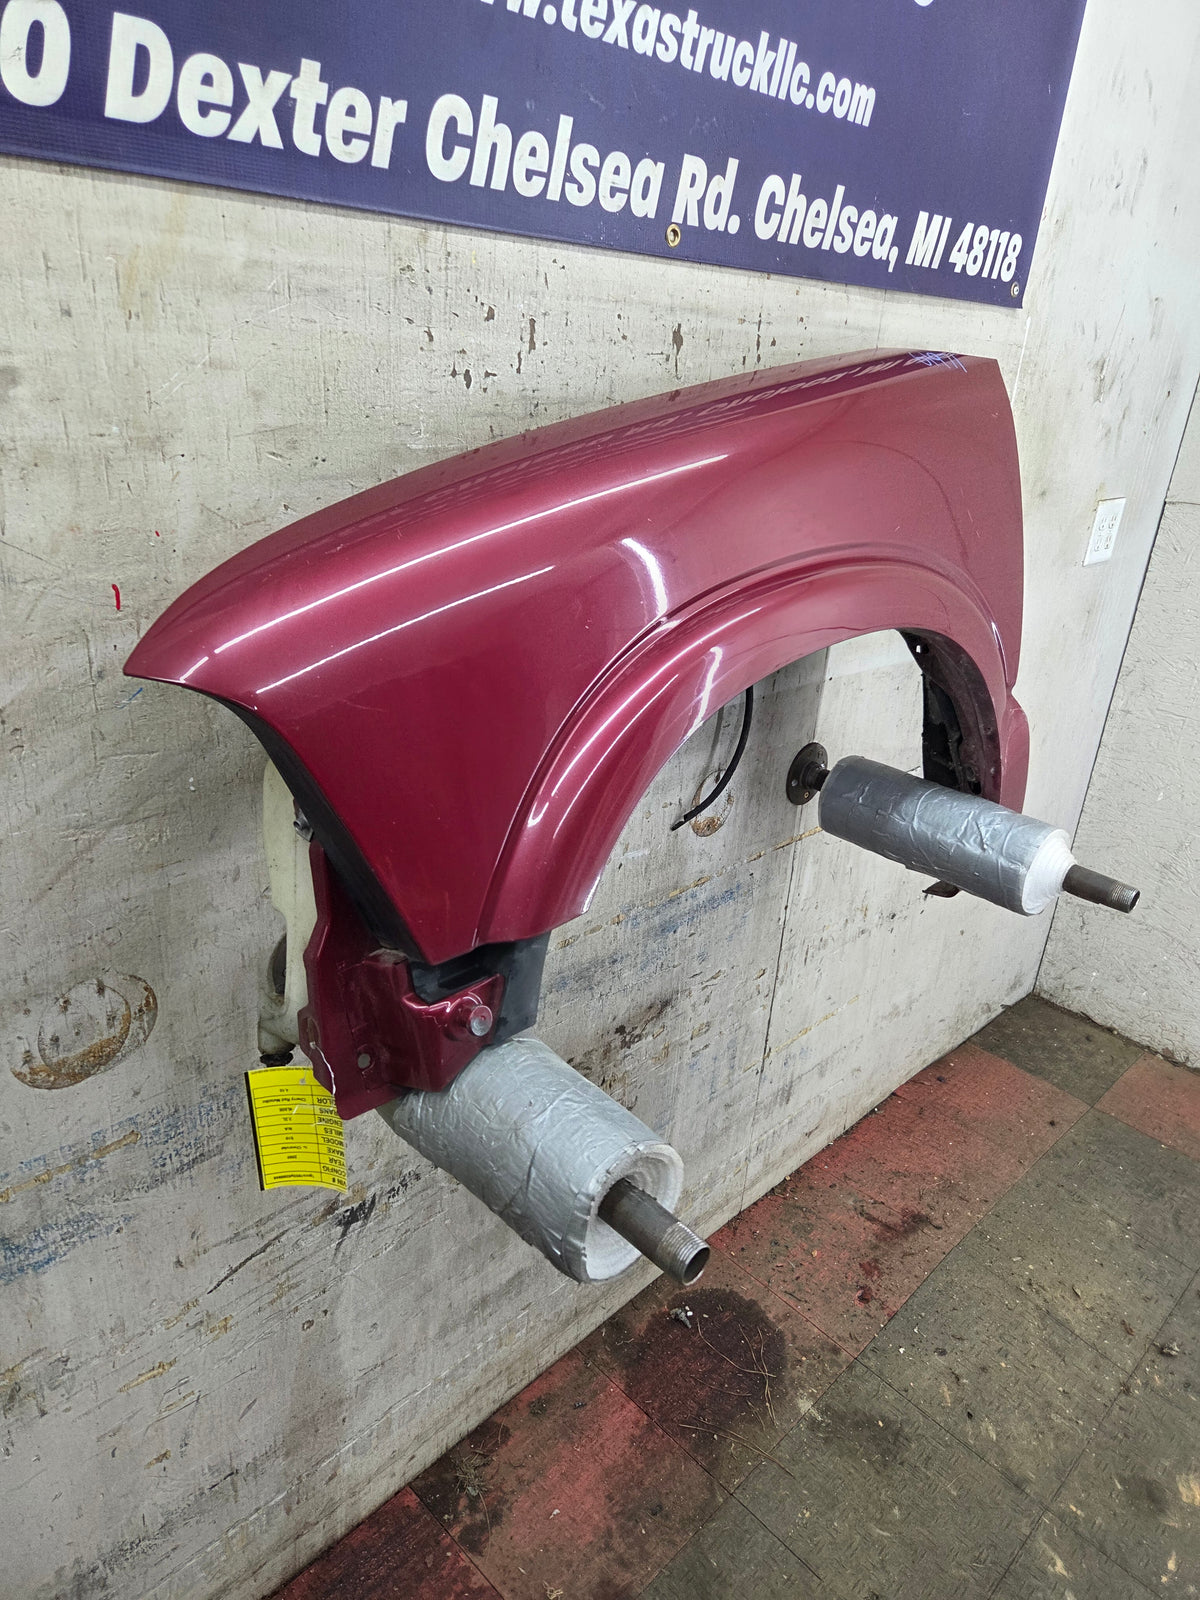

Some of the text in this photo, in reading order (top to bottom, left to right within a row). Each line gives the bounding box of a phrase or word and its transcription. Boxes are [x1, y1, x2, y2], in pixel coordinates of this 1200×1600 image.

[480, 0, 877, 127] .texastruckllc.com
[104, 11, 407, 169] Dexter
[425, 93, 665, 219] Chelsea
[671, 153, 741, 235] Rd.
[754, 173, 899, 273] Chelsea,
[905, 210, 953, 271] MI
[949, 221, 1024, 283] 48118
[319, 1108, 337, 1117] RANS
[317, 1116, 343, 1127] ENGINE
[324, 1127, 343, 1137] MILES
[321, 1136, 344, 1147] MODEL
[327, 1147, 344, 1156] MAKE
[329, 1157, 345, 1166] YEAR
[322, 1166, 346, 1176] CONFIG
